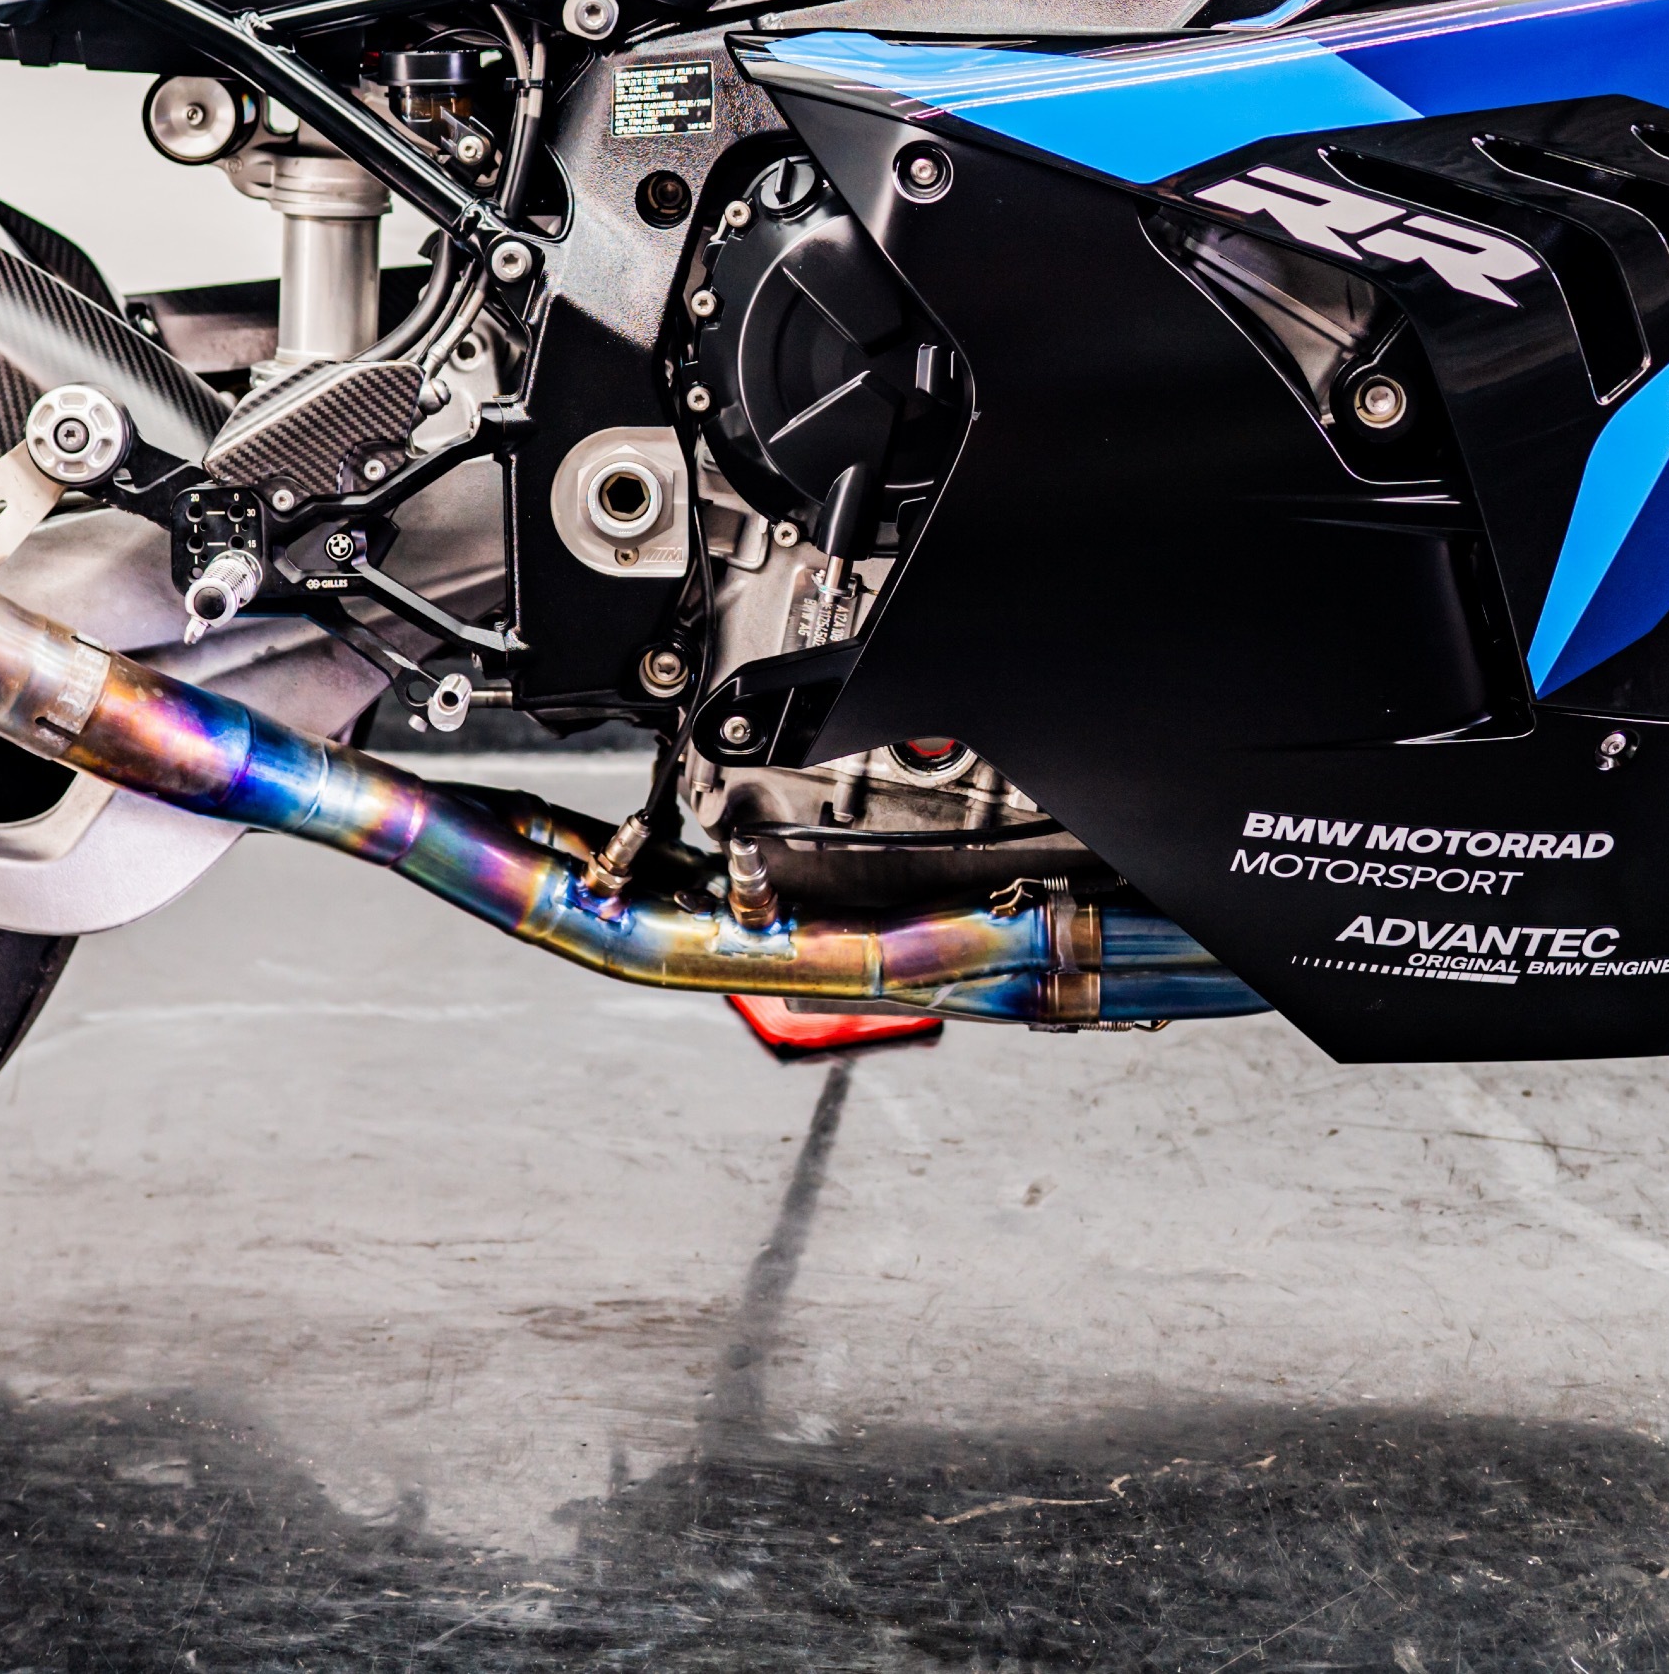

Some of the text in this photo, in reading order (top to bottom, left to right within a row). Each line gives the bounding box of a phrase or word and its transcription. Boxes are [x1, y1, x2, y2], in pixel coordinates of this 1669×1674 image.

[1193, 165, 1541, 308] RR
[190, 493, 239, 502] 20 0
[247, 509, 256, 517] 30
[248, 540, 257, 548] 15
[321, 579, 348, 588] GILLES
[798, 598, 817, 636] BMW AG
[1242, 811, 1615, 860] BMW MOTORRAD
[1230, 849, 1524, 896] MOTORSPORT
[1335, 914, 1621, 959] ADVANTEC
[1408, 952, 1521, 975] ORIGINAL
[1526, 960, 1587, 976] BMW
